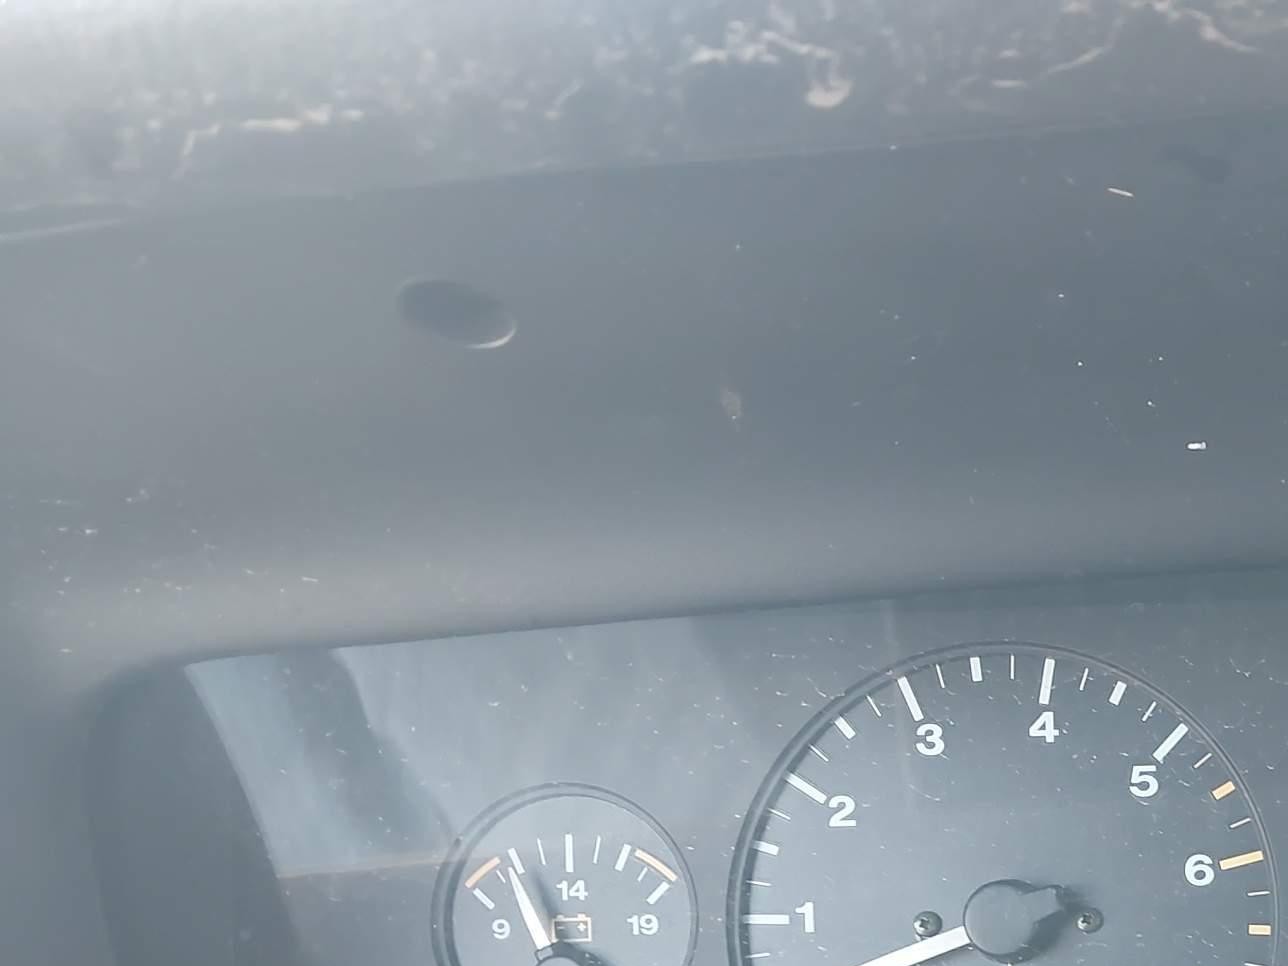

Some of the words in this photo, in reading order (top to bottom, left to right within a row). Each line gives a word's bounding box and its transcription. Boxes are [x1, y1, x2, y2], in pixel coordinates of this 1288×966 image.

[915, 723, 945, 756] 3
[1028, 711, 1060, 744] 4
[1129, 764, 1160, 798] 5
[828, 795, 857, 827] 2
[1184, 853, 1215, 887] 6
[556, 879, 589, 901] 14
[491, 919, 511, 940] 9
[626, 914, 660, 936] 19
[794, 901, 816, 934] 1
